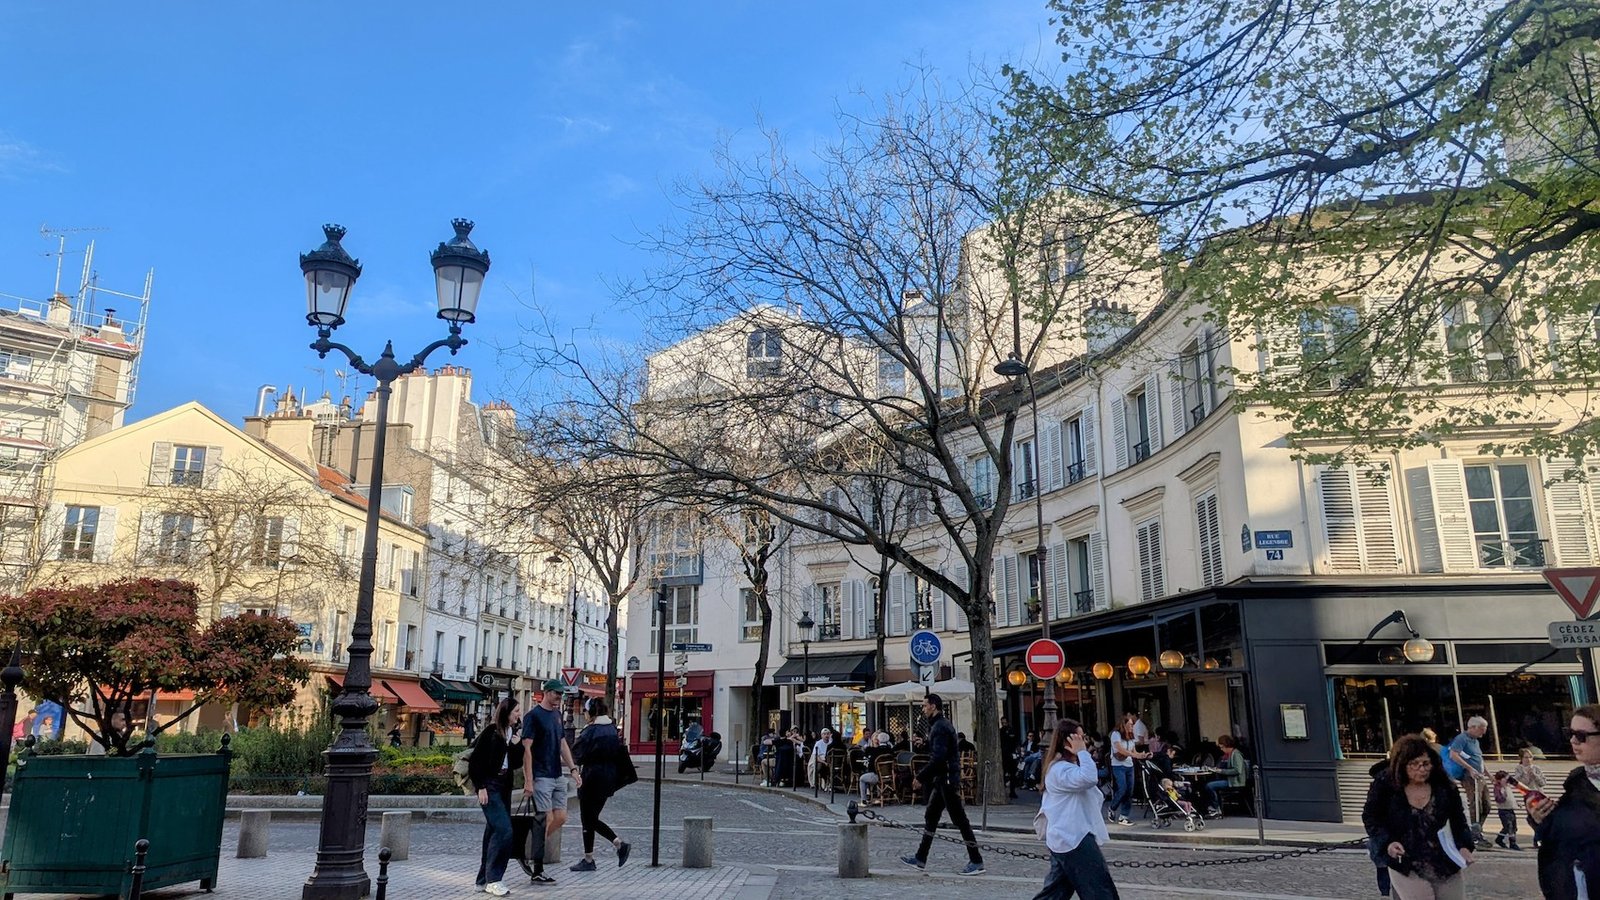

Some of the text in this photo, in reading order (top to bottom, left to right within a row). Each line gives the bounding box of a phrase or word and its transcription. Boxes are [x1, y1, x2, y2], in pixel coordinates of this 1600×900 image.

[1268, 550, 1281, 559] 74
[1559, 624, 1594, 633] CÉDEZ
[1563, 635, 1600, 644] PASSA
